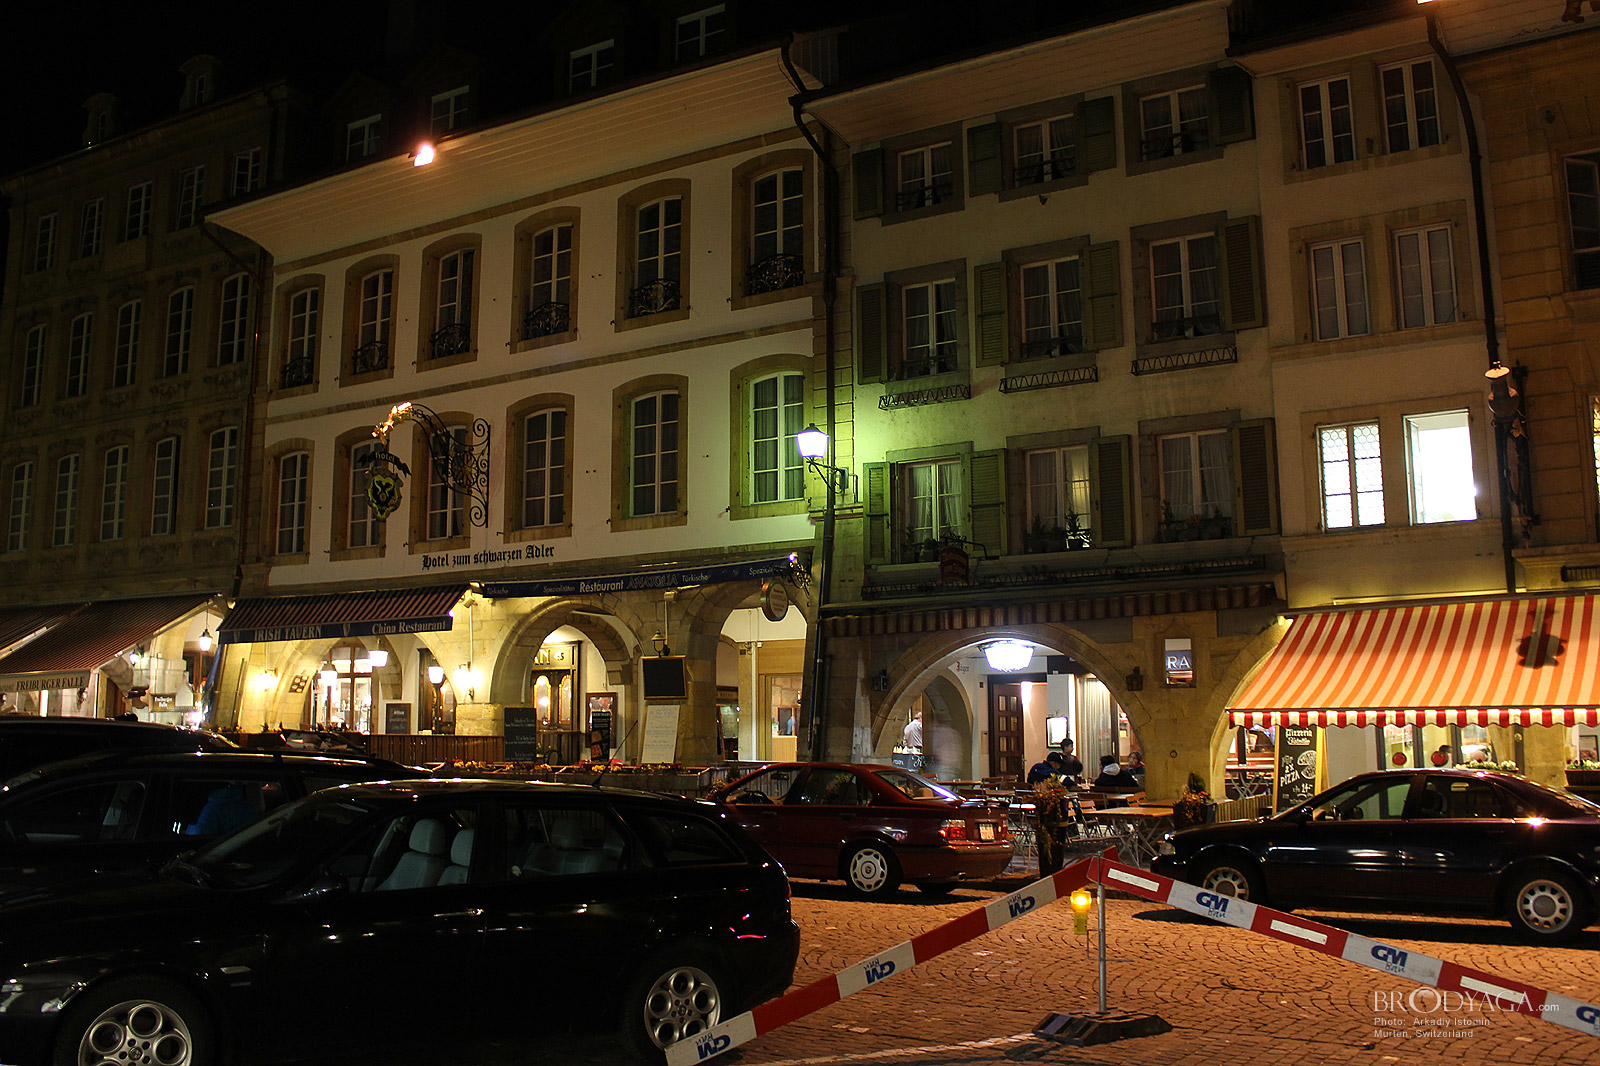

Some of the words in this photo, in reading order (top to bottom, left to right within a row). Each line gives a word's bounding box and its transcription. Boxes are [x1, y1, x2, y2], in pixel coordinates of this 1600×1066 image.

[422, 553, 449, 570] Hotel
[452, 555, 471, 567] zum
[473, 548, 522, 564] schwarzen
[525, 544, 555, 559] Adler
[579, 580, 624, 593] Restaurant
[682, 573, 710, 583] Türkische
[254, 628, 281, 641] IRISH
[285, 626, 322, 640] TAVERN
[372, 622, 396, 635] China
[398, 620, 446, 633] Restaurant
[1167, 655, 1192, 669] RA
[16, 679, 61, 691] FREIBURGER
[62, 676, 85, 688] FALLE
[1280, 769, 1301, 787] PIZZA
[1009, 896, 1036, 918] GM
[1196, 892, 1229, 912] GM
[1371, 945, 1408, 967] GM
[865, 961, 896, 984] GM
[1576, 1006, 1600, 1025] G
[697, 1034, 731, 1060] GM
